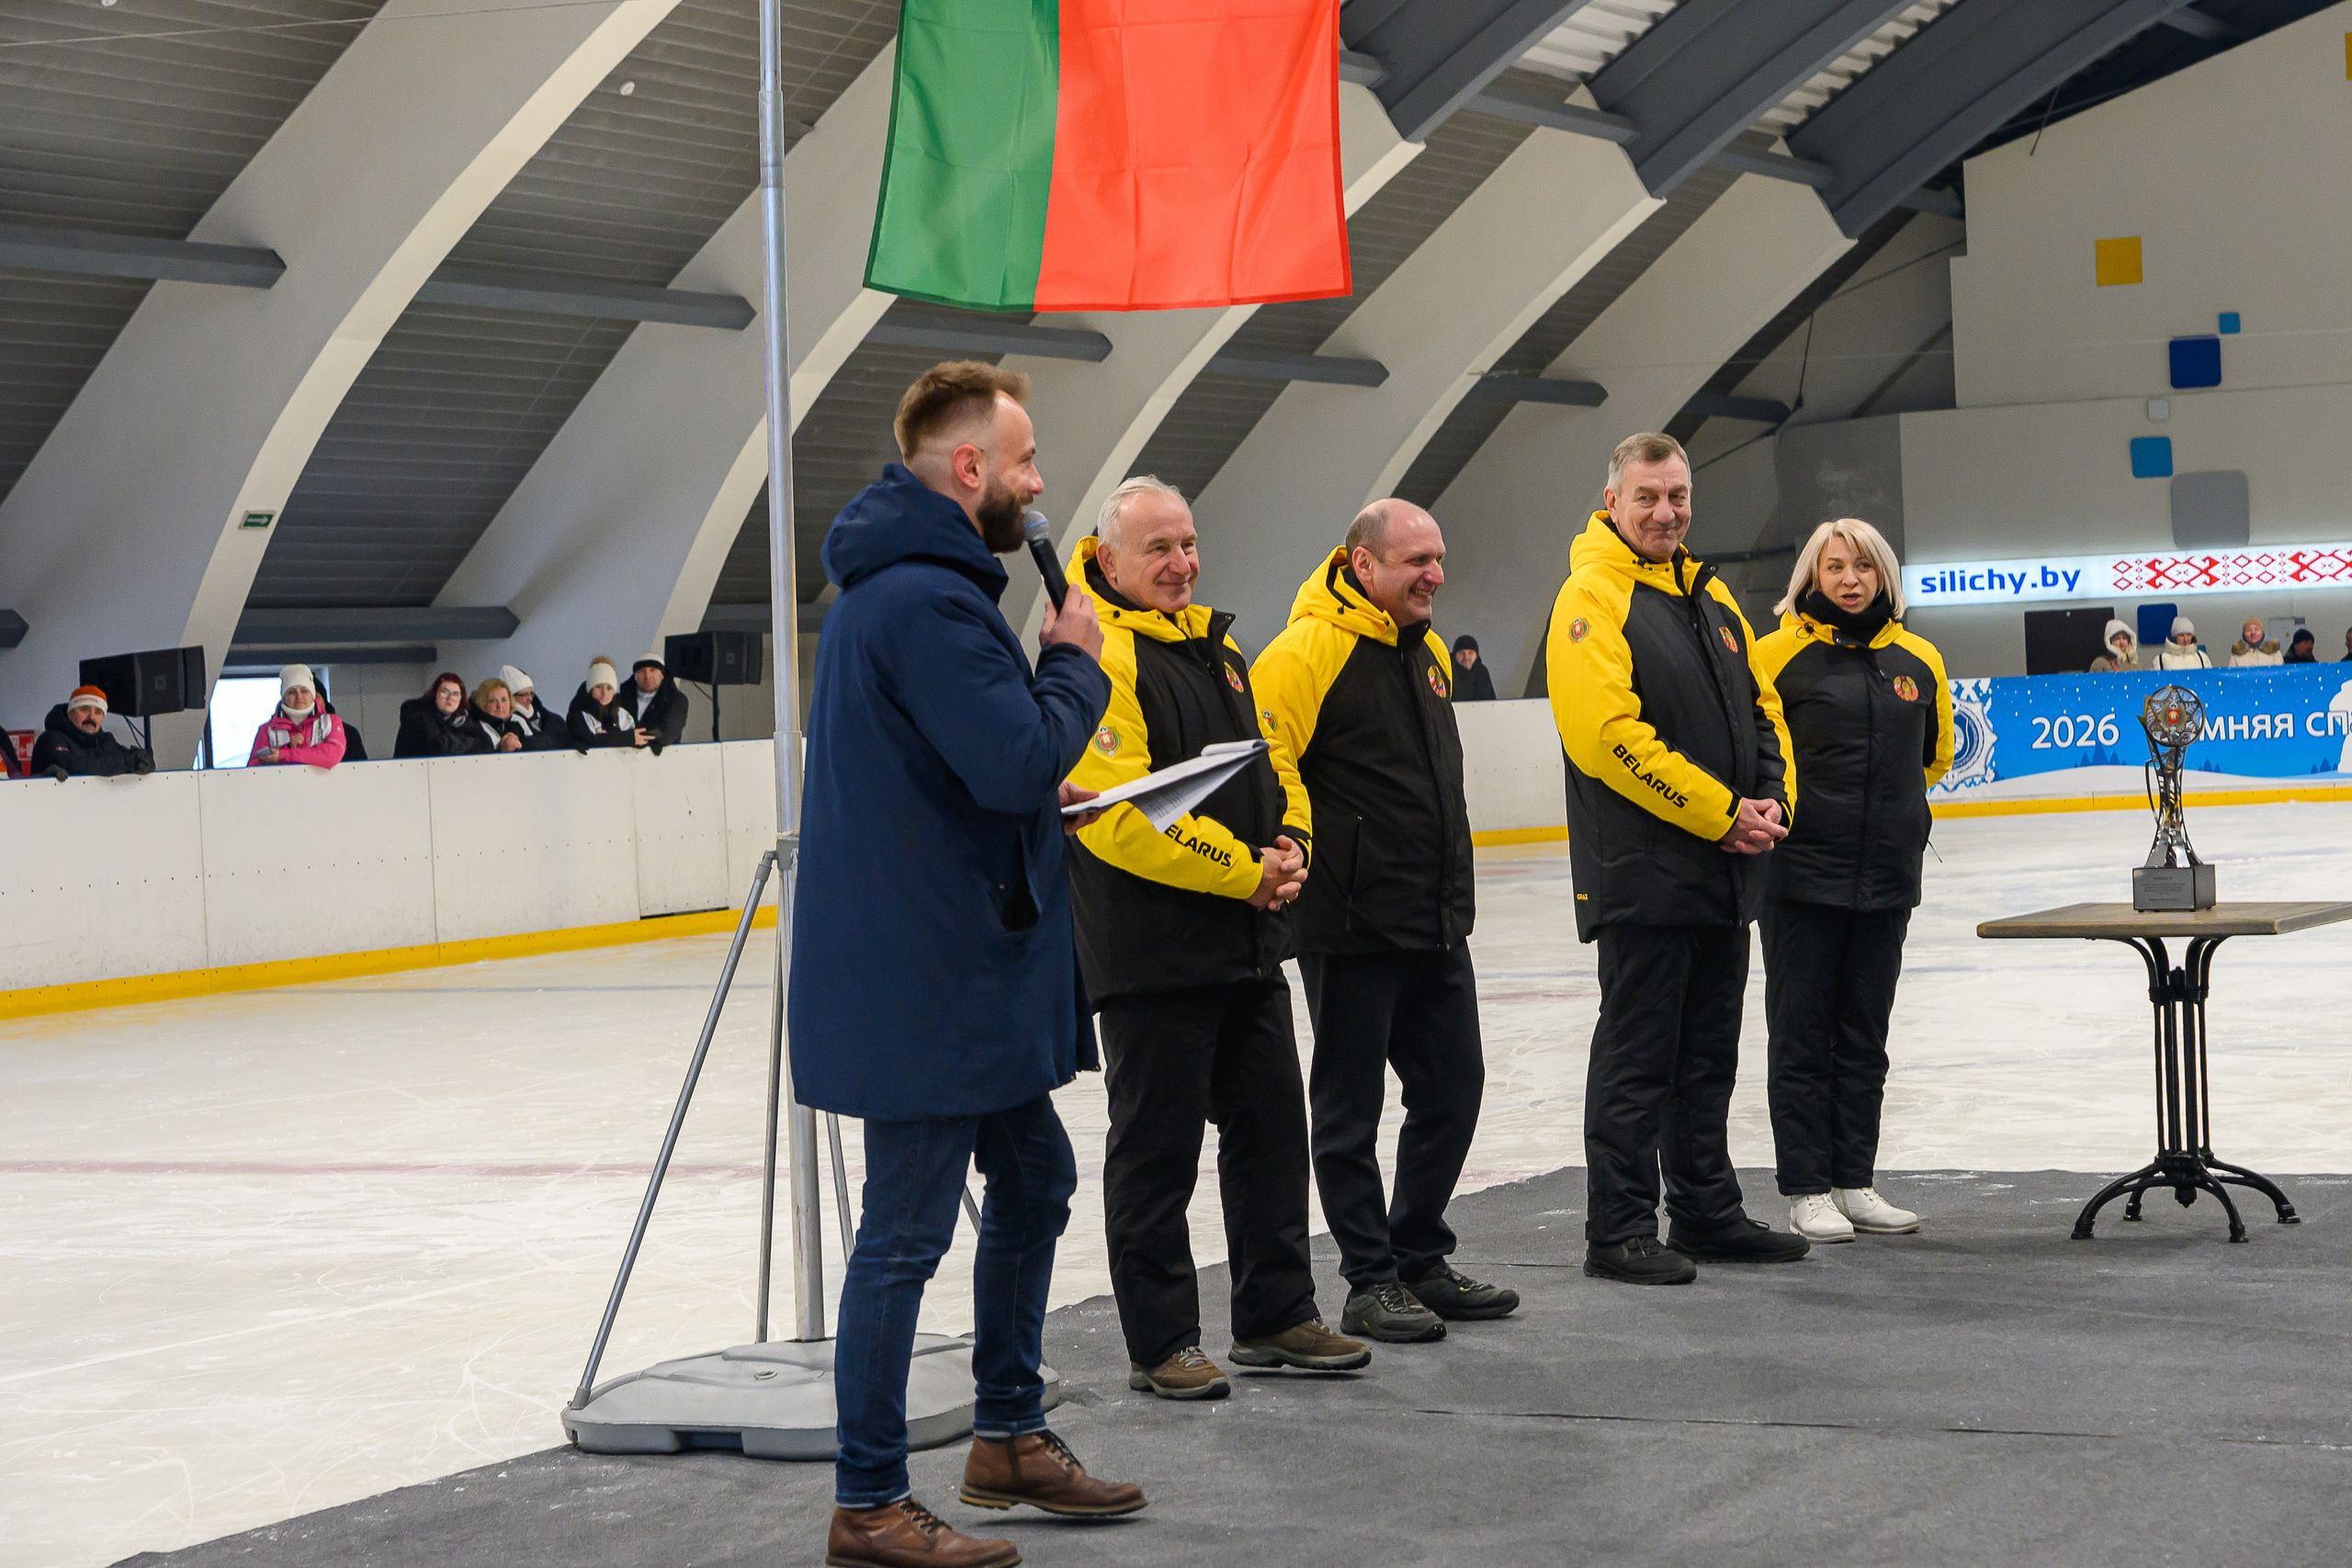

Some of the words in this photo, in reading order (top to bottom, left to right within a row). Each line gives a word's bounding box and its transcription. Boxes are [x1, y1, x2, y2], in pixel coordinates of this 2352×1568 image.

[1920, 566, 2081, 595] silichy.by
[2031, 713, 2120, 749] 2026
[2199, 713, 2295, 741] МНЯЯ
[2305, 710, 2352, 738] СП
[1612, 743, 1689, 808] BELARUS
[1163, 824, 1232, 868] ELARUS
